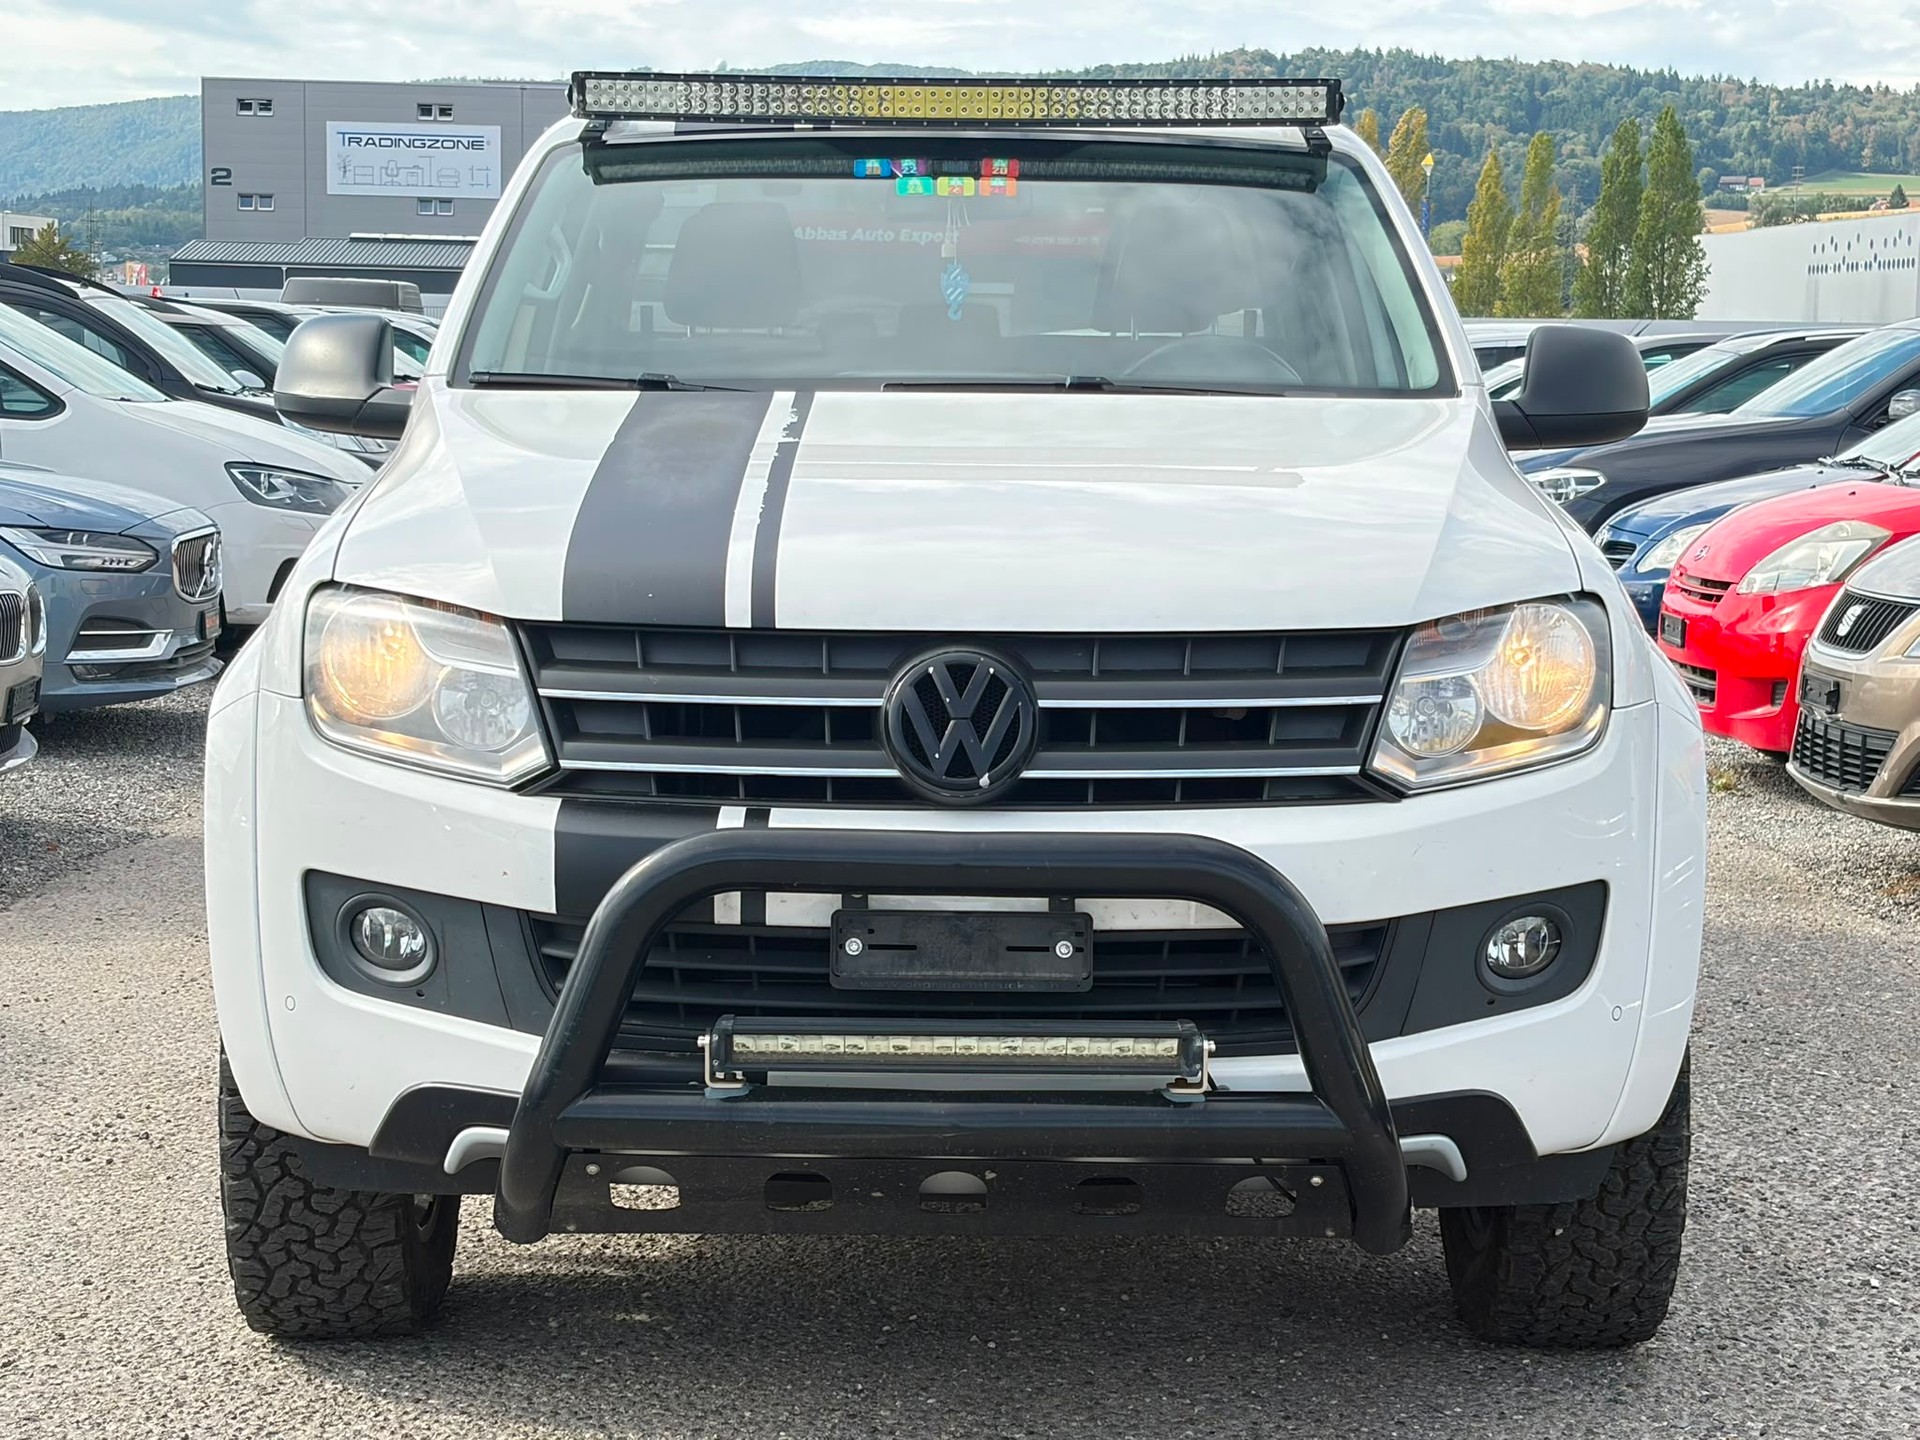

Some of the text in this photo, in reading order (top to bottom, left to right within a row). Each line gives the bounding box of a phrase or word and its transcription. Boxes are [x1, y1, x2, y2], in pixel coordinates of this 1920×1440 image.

[210, 167, 232, 186] 2
[794, 225, 848, 241] Abbas
[850, 227, 895, 242] Auto
